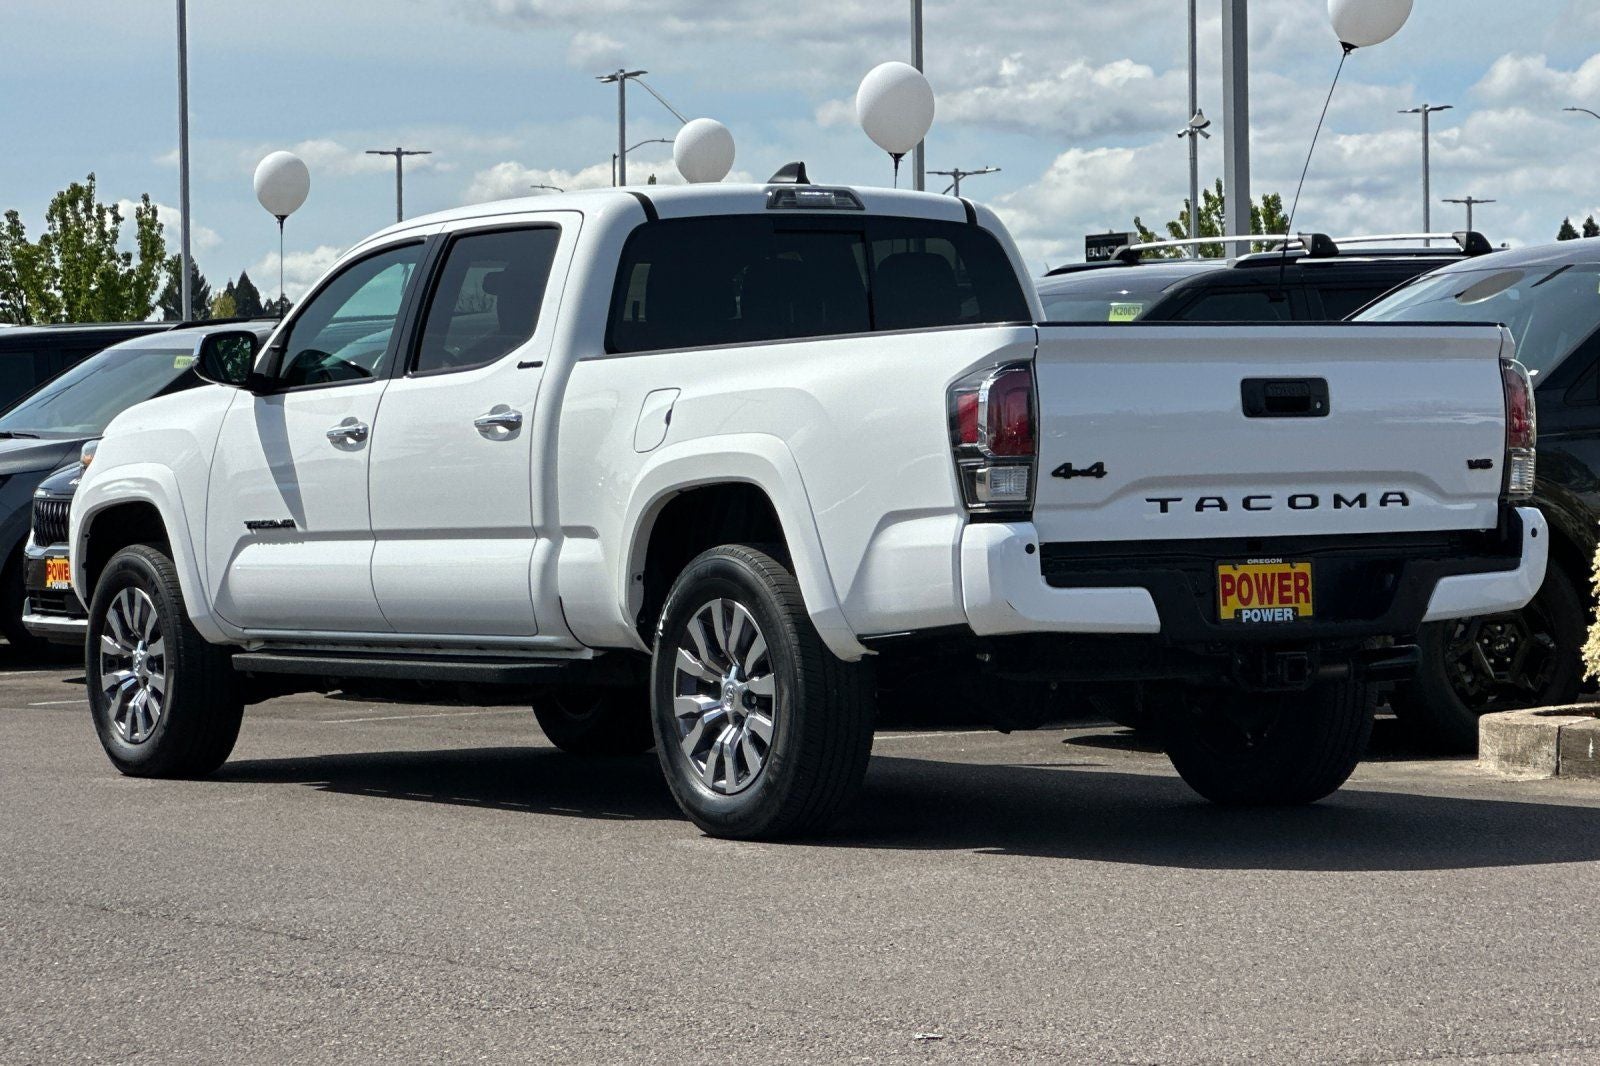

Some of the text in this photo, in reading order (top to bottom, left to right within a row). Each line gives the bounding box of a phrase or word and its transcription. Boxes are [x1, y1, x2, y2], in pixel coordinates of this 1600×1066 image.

[1087, 245, 1118, 257] BUIC
[1145, 491, 1409, 513] TACOMA
[46, 563, 71, 581] POWE
[1220, 572, 1310, 606] POWER
[1242, 608, 1293, 623] POWER
